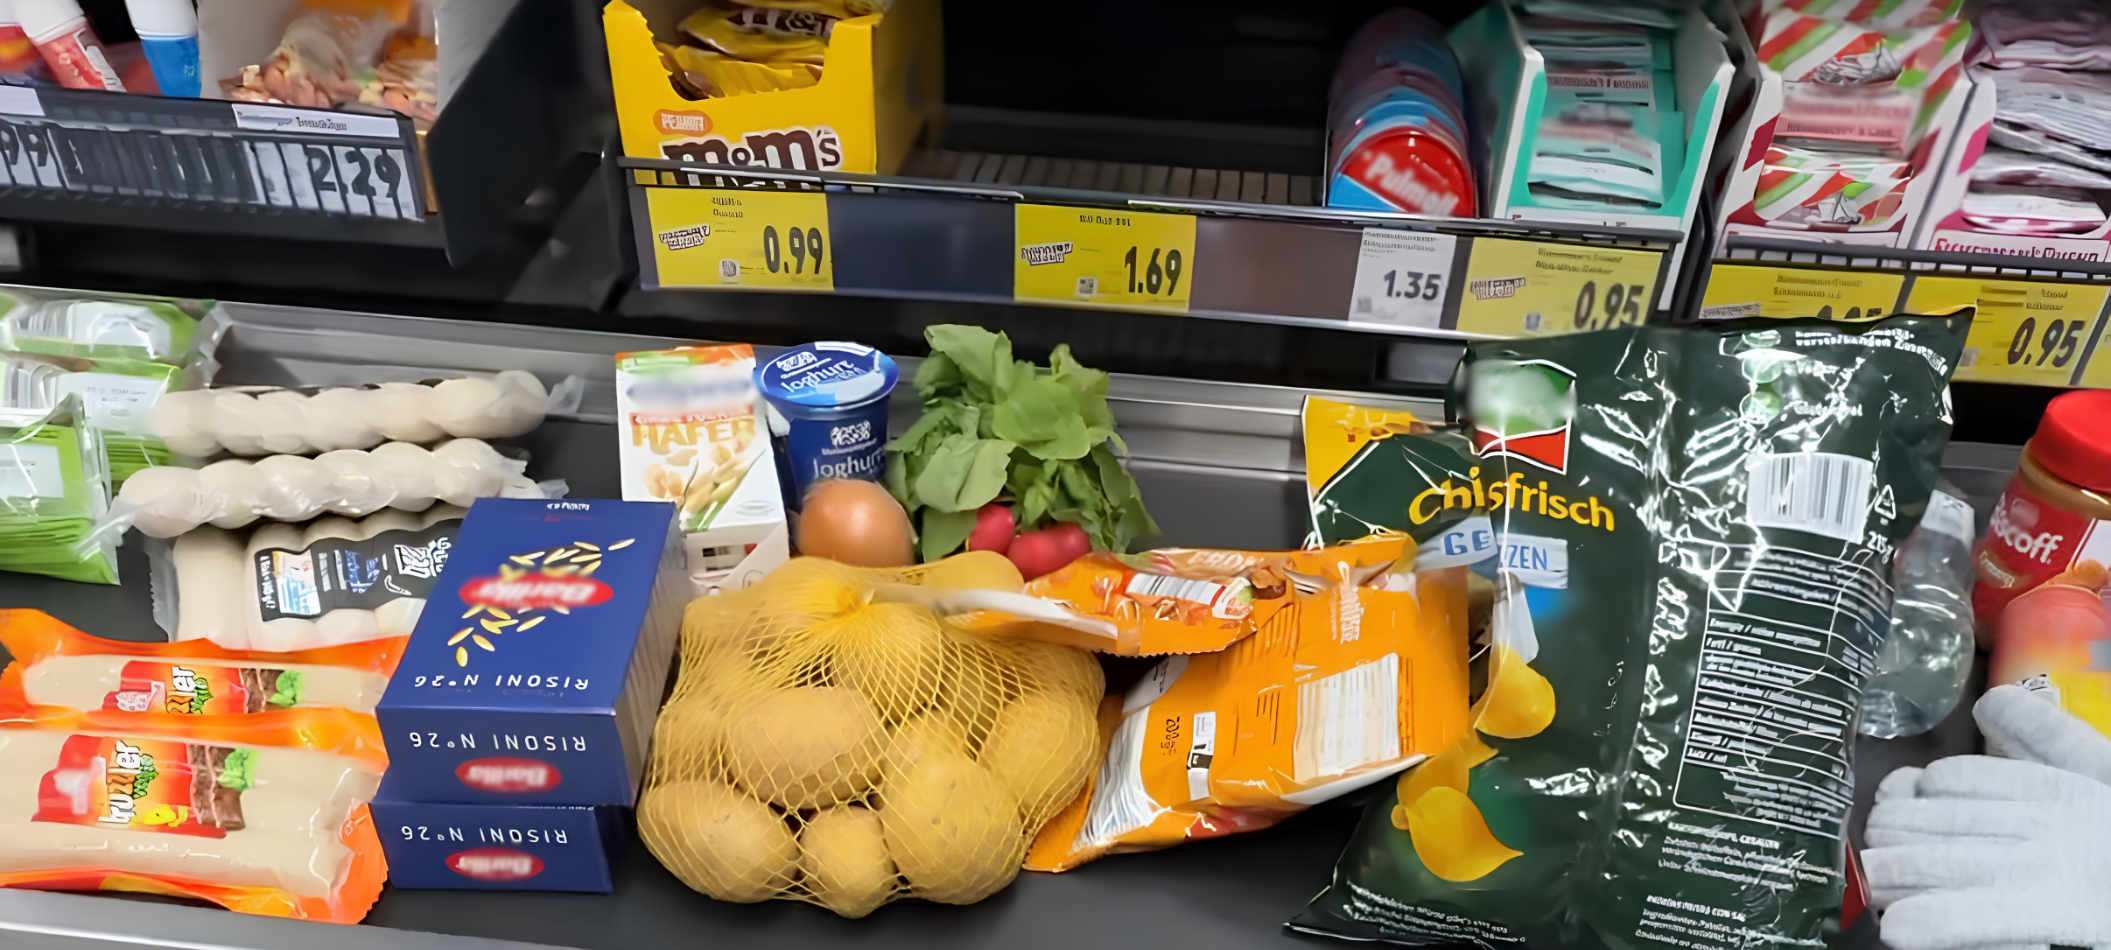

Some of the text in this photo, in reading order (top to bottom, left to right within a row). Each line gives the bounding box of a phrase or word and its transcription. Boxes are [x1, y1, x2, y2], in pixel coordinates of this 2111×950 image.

[763, 225, 824, 275] 0.99
[1124, 245, 1183, 297] 1.69
[1383, 269, 1442, 301] 1.35
[1573, 280, 1646, 331] 0.95
[2007, 316, 2086, 368] 0.95
[495, 675, 589, 691] RISONI
[494, 733, 587, 752] RISONI
[479, 827, 568, 845] RISONI
